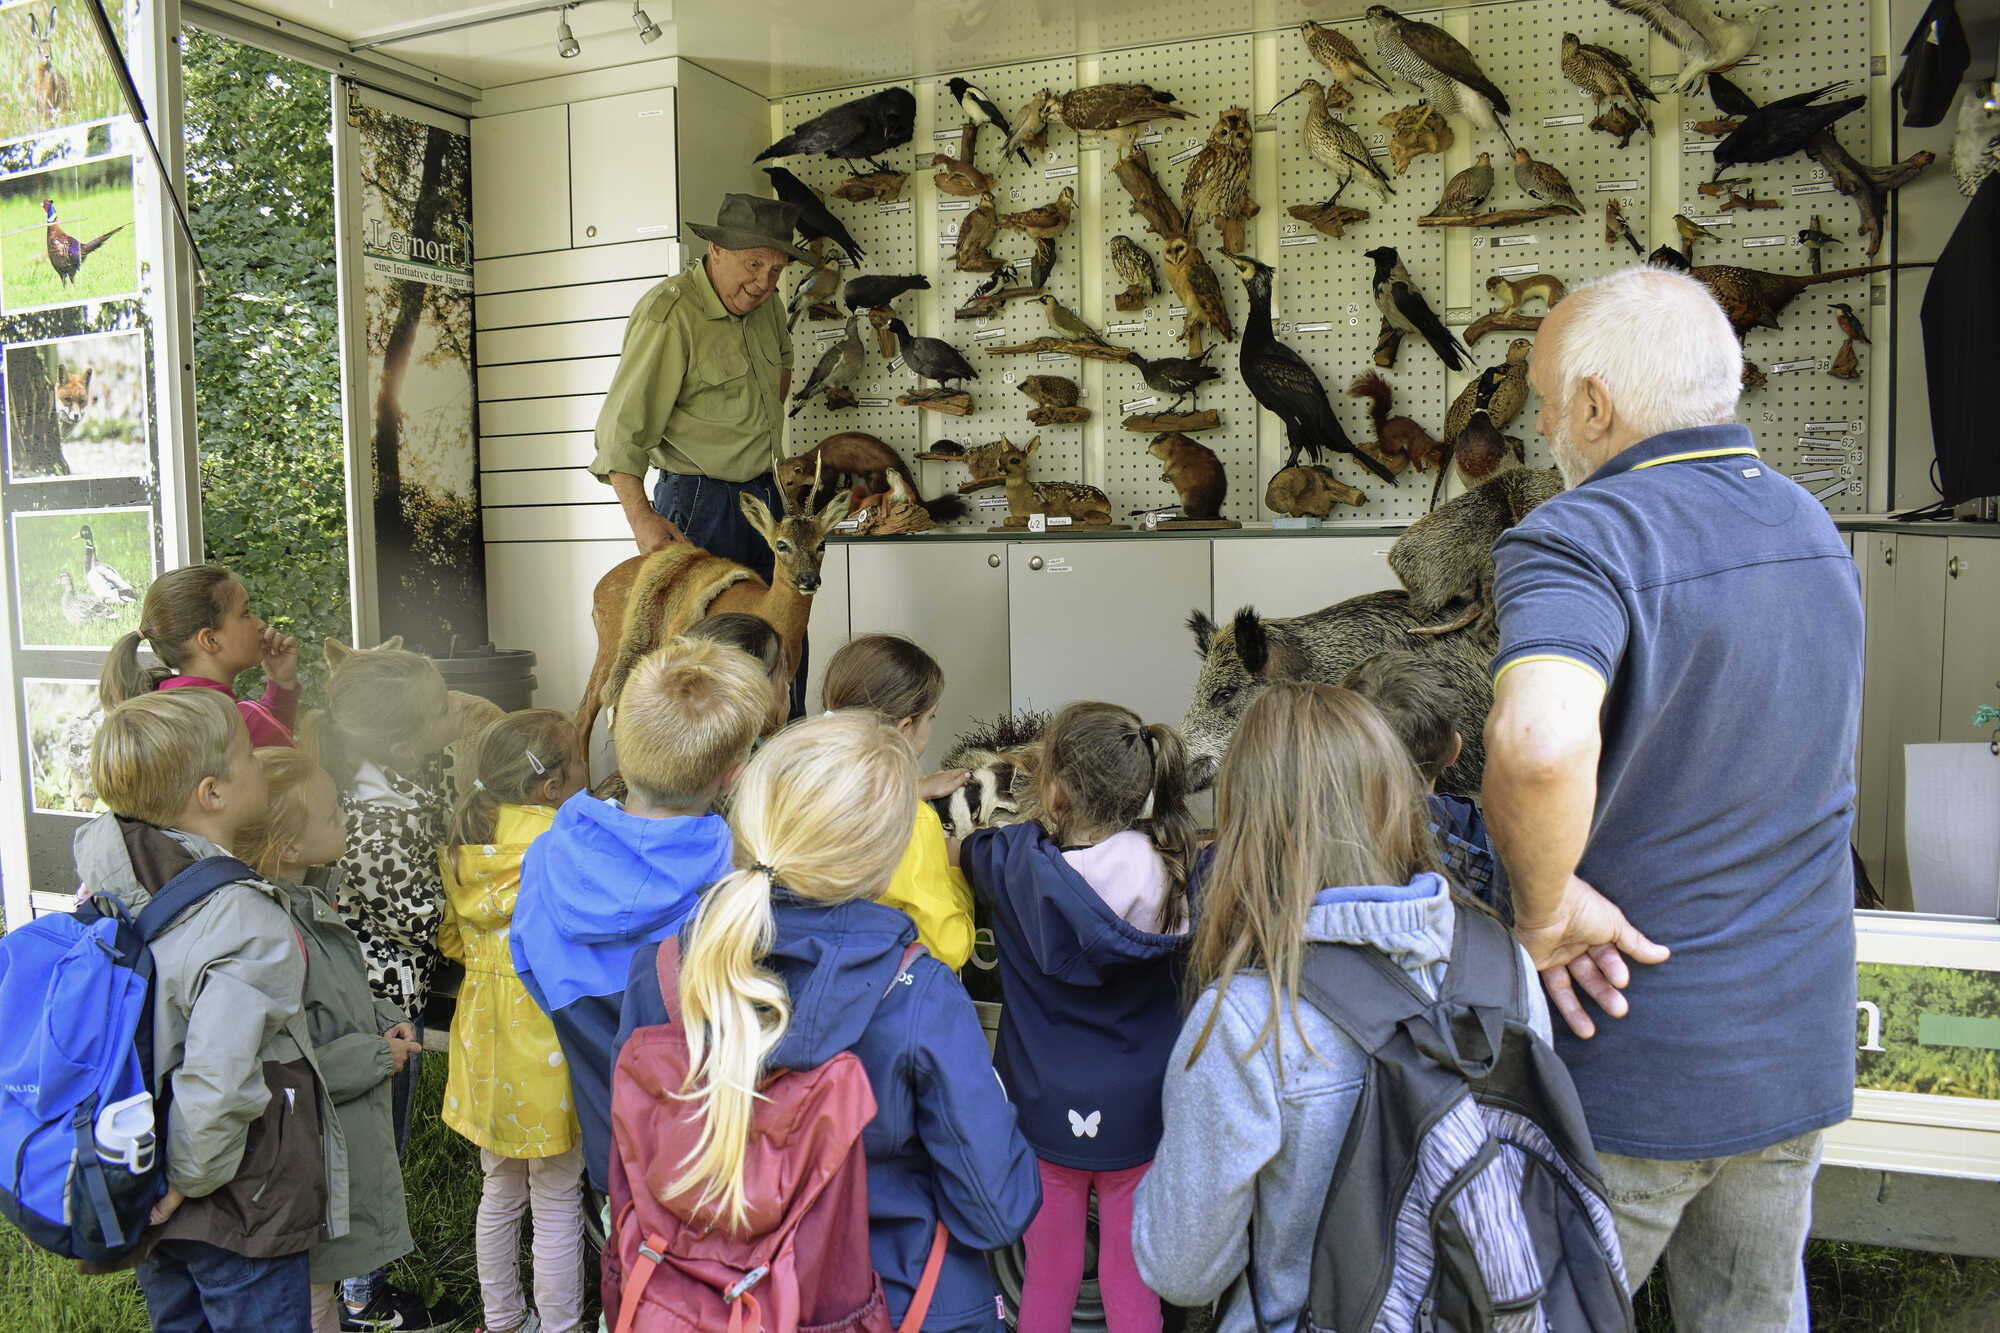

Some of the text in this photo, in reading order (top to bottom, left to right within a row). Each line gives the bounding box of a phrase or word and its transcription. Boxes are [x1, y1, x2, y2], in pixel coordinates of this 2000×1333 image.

[1684, 121, 1697, 131] 32
[1373, 134, 1384, 144] 22
[1811, 169, 1825, 180] 33
[1622, 198, 1633, 208] 34
[1682, 206, 1694, 216] 35
[1286, 224, 1297, 233] 23
[370, 218, 457, 265] Lernort
[1473, 237, 1484, 247] 27
[374, 261, 392, 273] eine
[393, 263, 429, 281] Initiative
[430, 271, 443, 283] der
[444, 273, 465, 288] Jäger
[1349, 303, 1358, 313] 24
[1280, 323, 1291, 332] 25
[1816, 360, 1830, 370] 38
[1137, 382, 1146, 392] 20
[1762, 412, 1774, 422] 54
[1851, 422, 1862, 432] 61
[1841, 437, 1855, 448] 62
[1850, 451, 1863, 462] 63
[1840, 466, 1852, 476] 64
[1849, 482, 1862, 493] 65
[1029, 520, 1041, 529] 42
